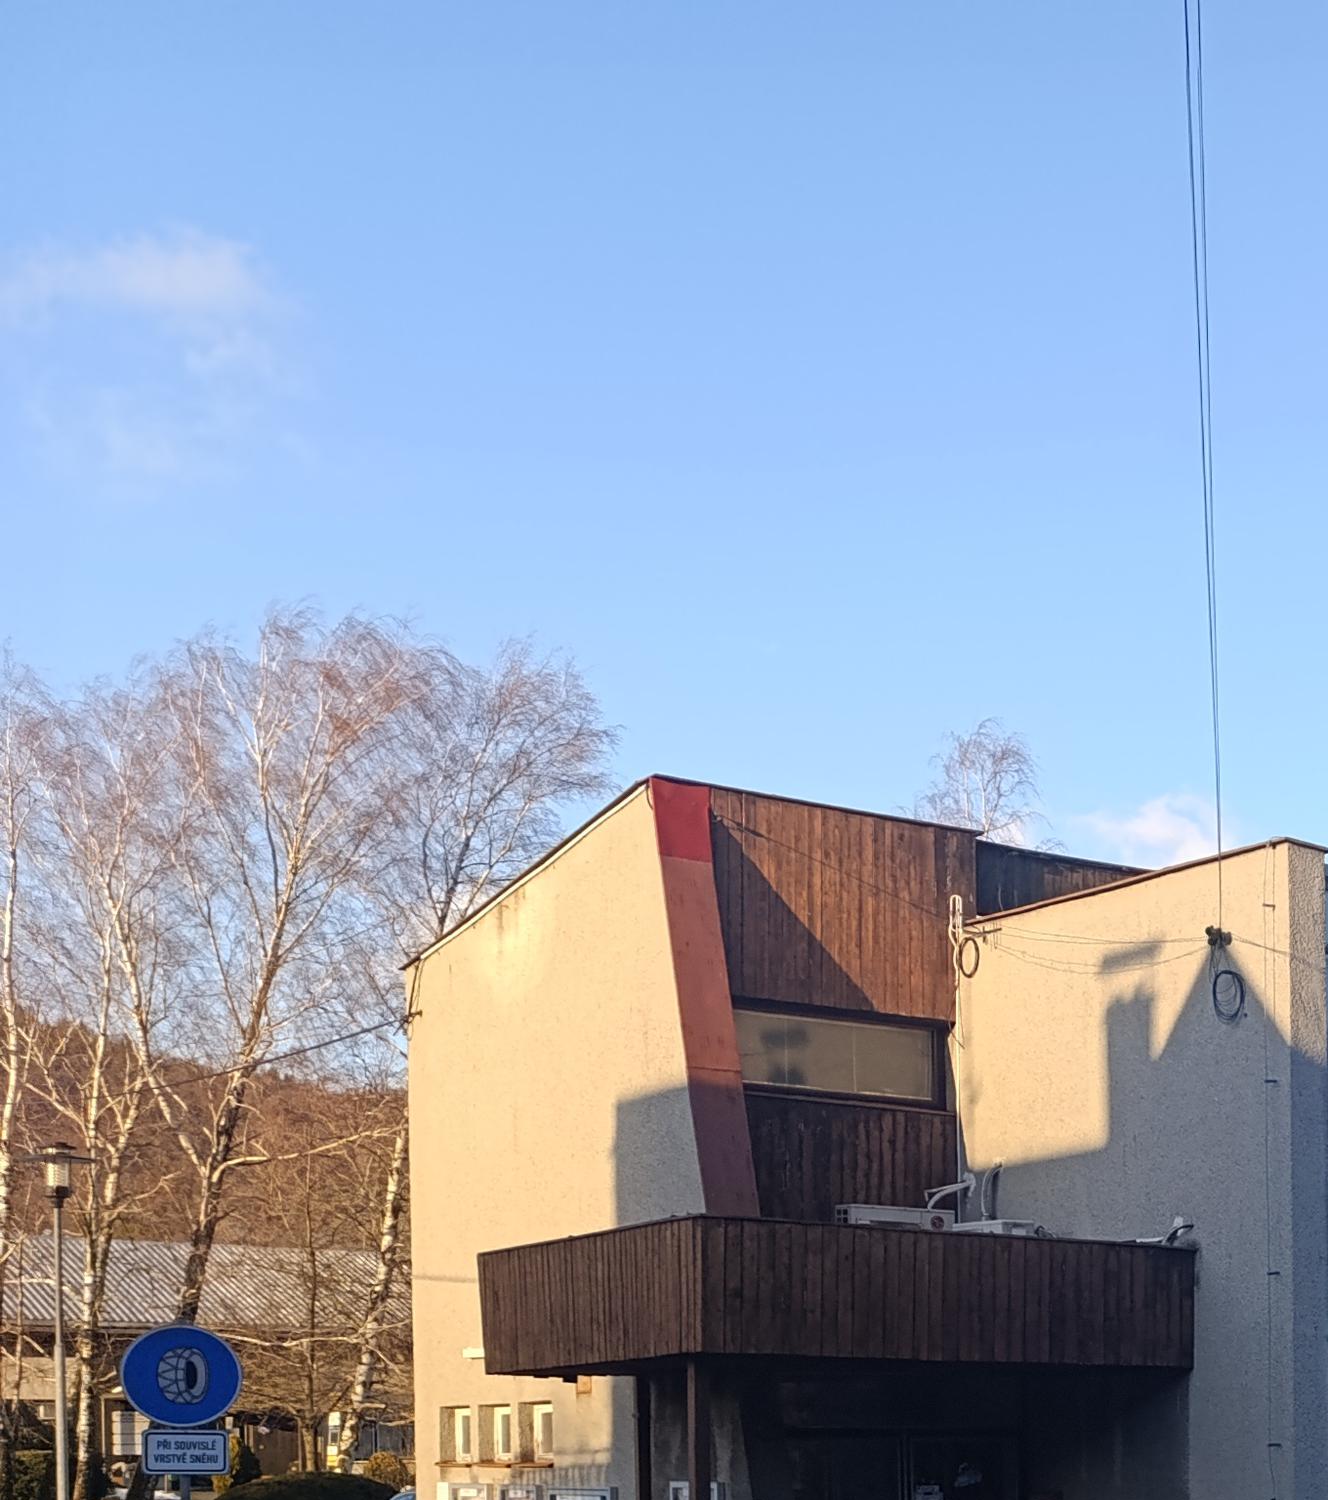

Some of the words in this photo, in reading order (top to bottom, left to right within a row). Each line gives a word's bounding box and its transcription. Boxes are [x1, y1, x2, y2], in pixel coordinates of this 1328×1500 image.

[156, 1438, 172, 1451] PŘI
[174, 1439, 217, 1451] SOUVISLÉ
[153, 1451, 188, 1464] VRSTVĚ
